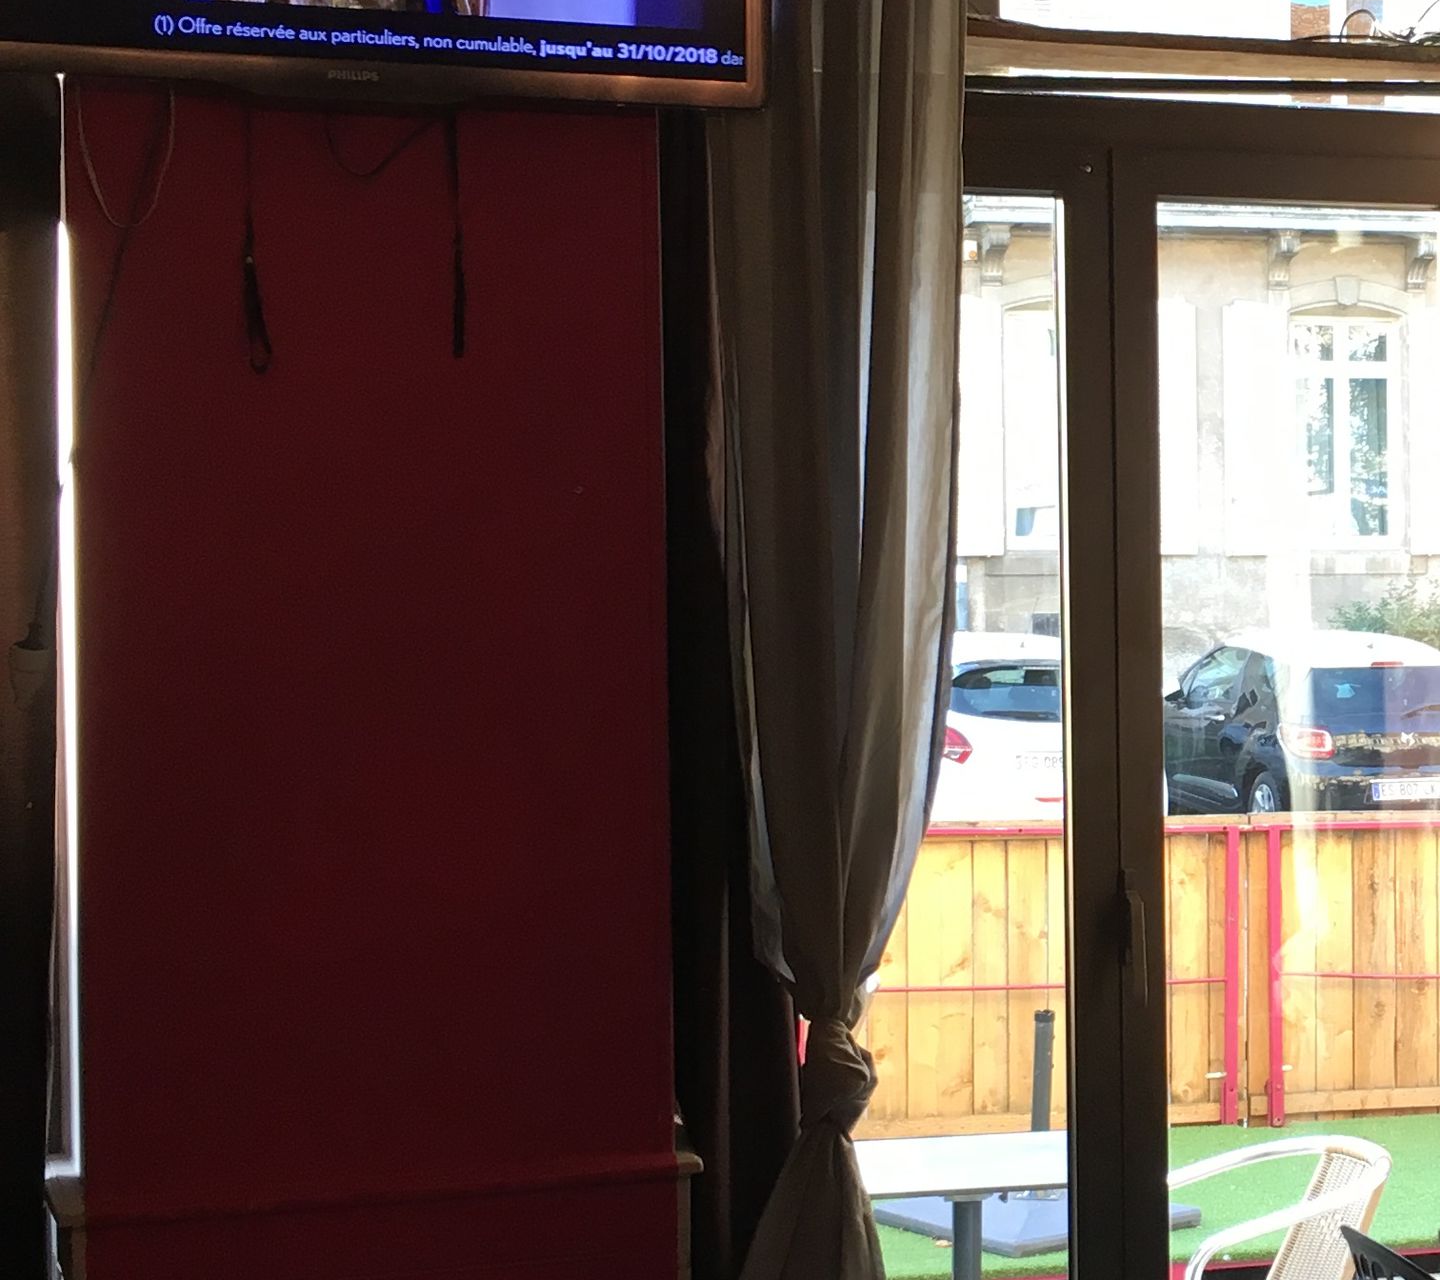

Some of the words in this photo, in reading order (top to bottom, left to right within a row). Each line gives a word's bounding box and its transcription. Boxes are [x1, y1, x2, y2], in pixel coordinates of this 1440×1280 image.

[154, 15, 174, 36] (1)
[178, 16, 223, 36] Offre
[226, 22, 295, 40] réservée
[299, 28, 327, 42] aux
[331, 29, 420, 49] particuliers,
[423, 36, 453, 49] non
[456, 36, 537, 56] cumulable,
[539, 40, 614, 60] jusqu'au
[617, 43, 718, 64] 31/10/2018
[328, 70, 380, 81] PHILIPS
